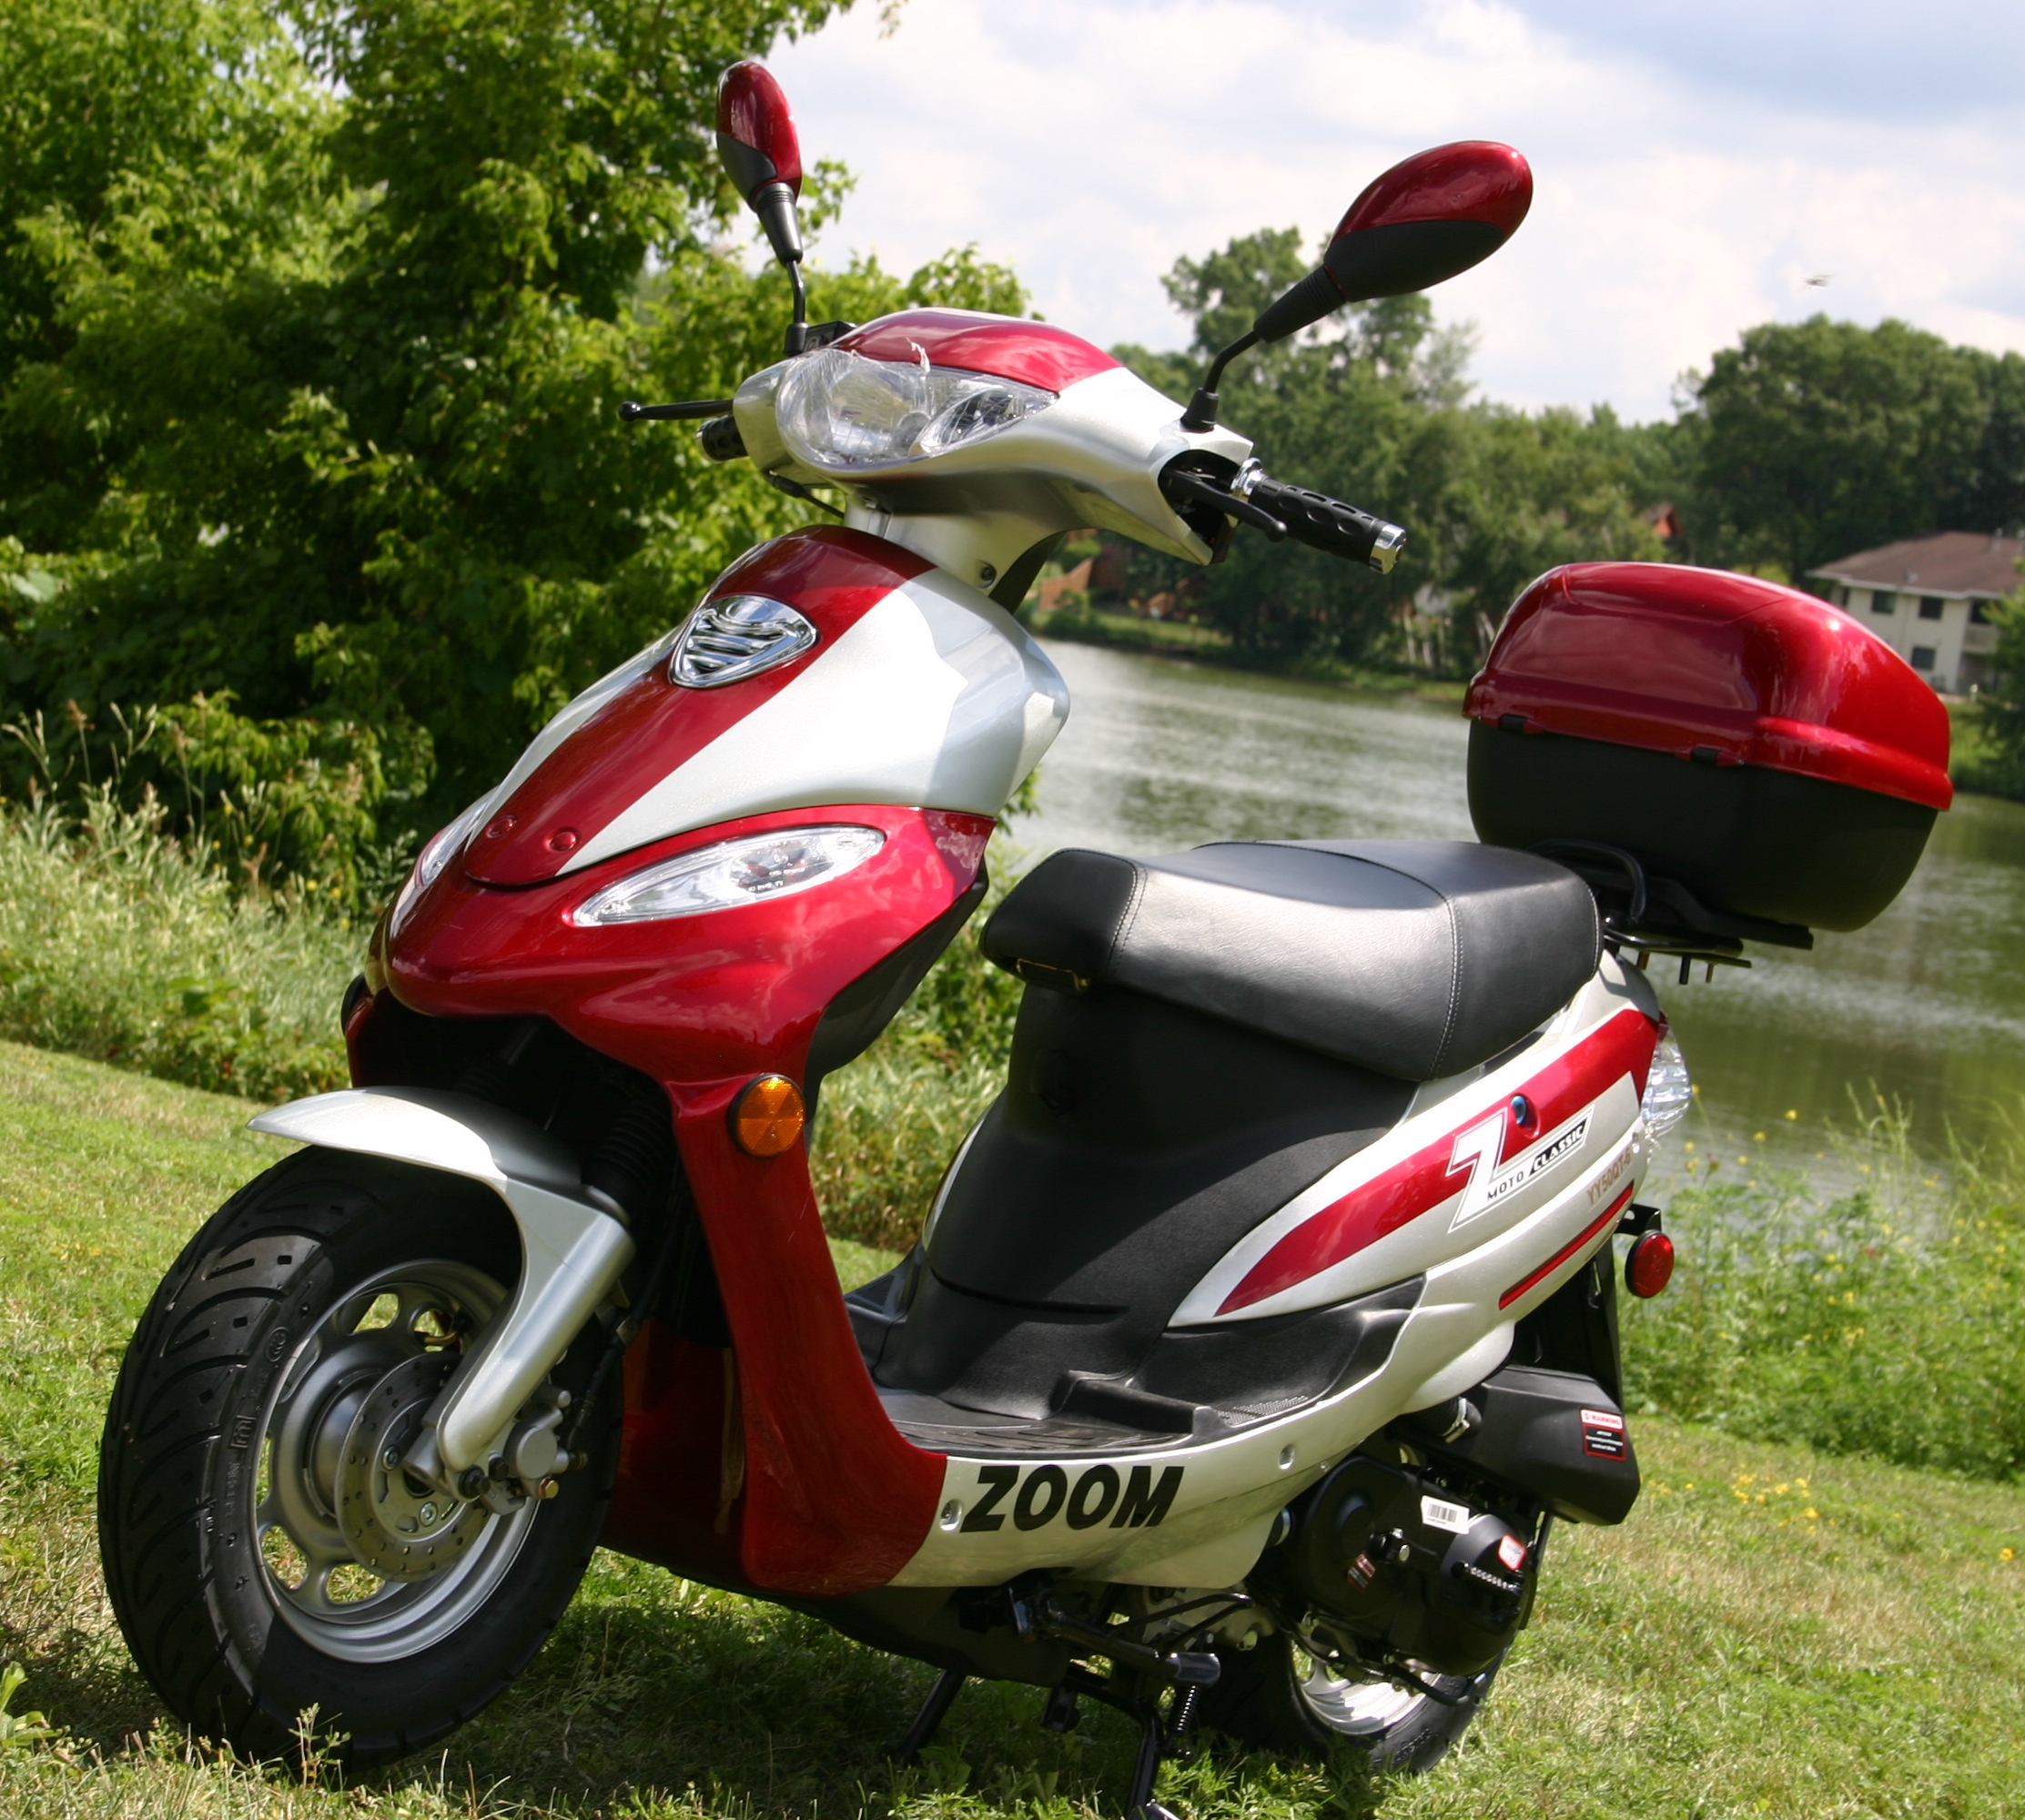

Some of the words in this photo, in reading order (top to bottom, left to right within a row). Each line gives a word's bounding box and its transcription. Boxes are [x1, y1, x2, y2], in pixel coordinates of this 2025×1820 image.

[1487, 1171, 1524, 1201] MOTO
[1533, 1123, 1585, 1171] CLASSIC
[959, 1464, 1185, 1532] ZOOM
